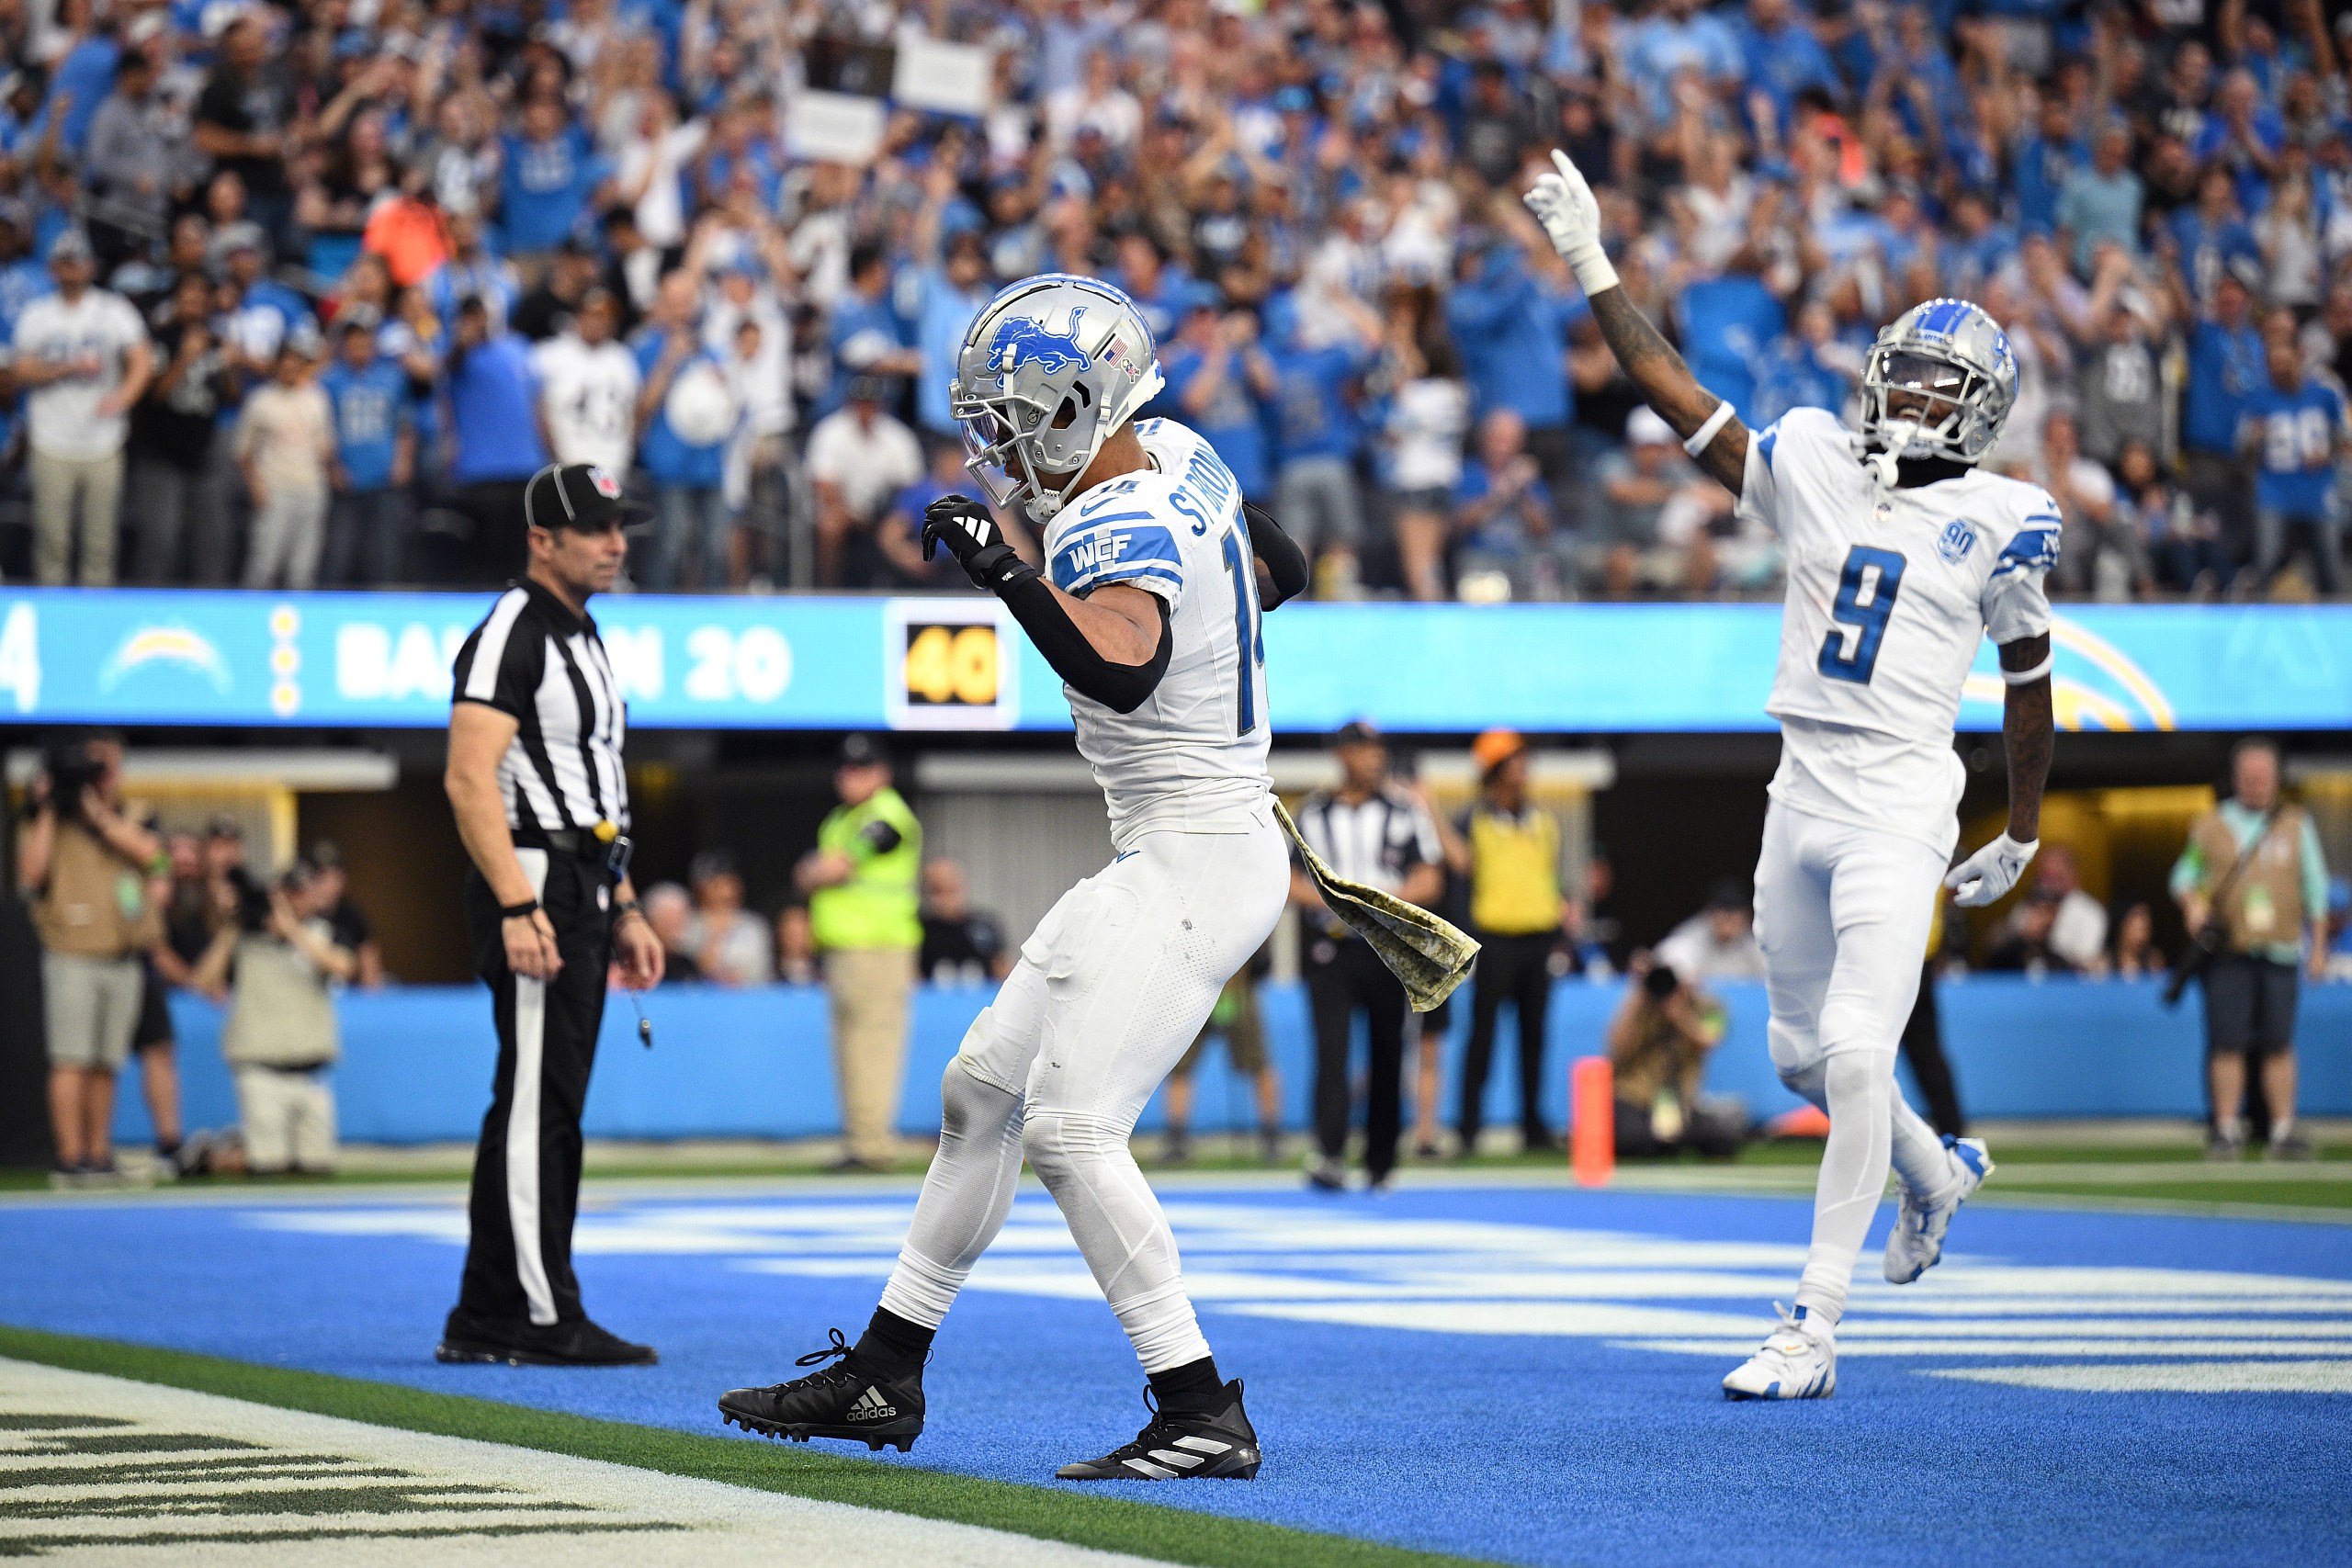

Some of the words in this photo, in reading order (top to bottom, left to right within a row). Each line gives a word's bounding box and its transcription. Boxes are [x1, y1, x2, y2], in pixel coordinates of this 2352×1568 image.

[1068, 534, 1132, 573] WCF
[1818, 545, 1907, 686] 9
[684, 625, 792, 704] 20
[902, 625, 1004, 705] 40
[846, 1406, 897, 1422] adidas
